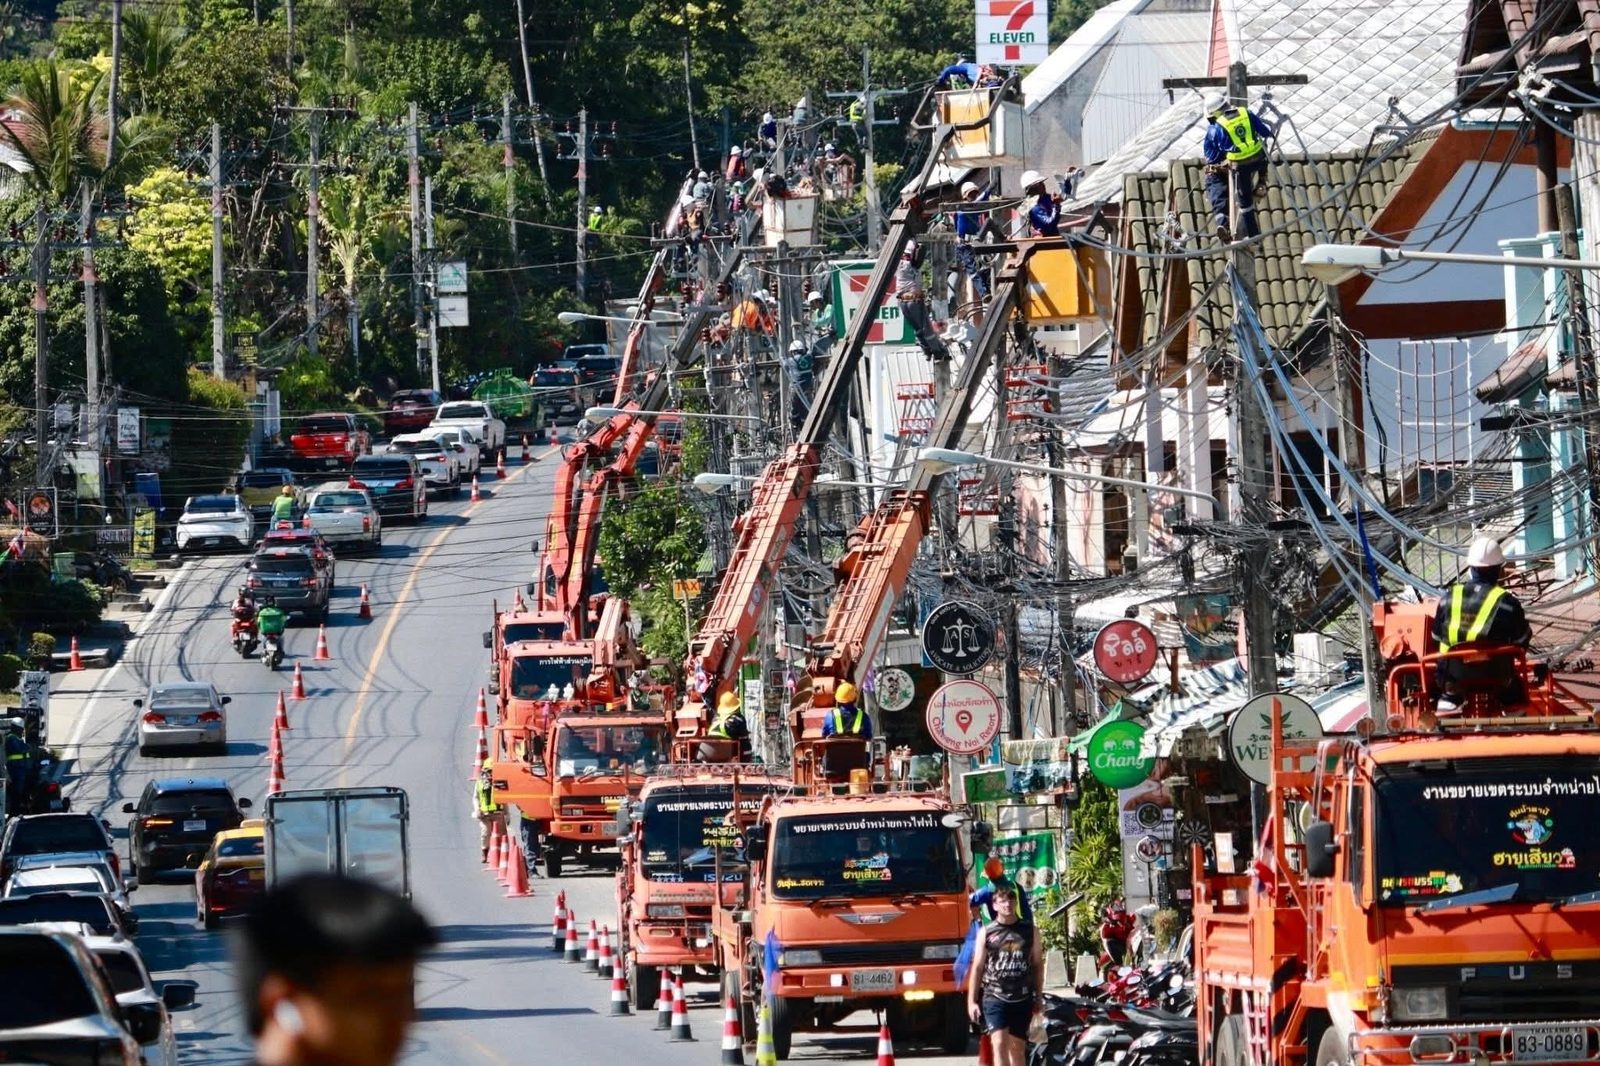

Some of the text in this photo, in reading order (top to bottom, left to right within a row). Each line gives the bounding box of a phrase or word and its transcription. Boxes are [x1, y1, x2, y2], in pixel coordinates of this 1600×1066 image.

[1095, 752, 1146, 769] Chang
[704, 874, 743, 882] ISZU
[1517, 1034, 1584, 1054] 83-0889
